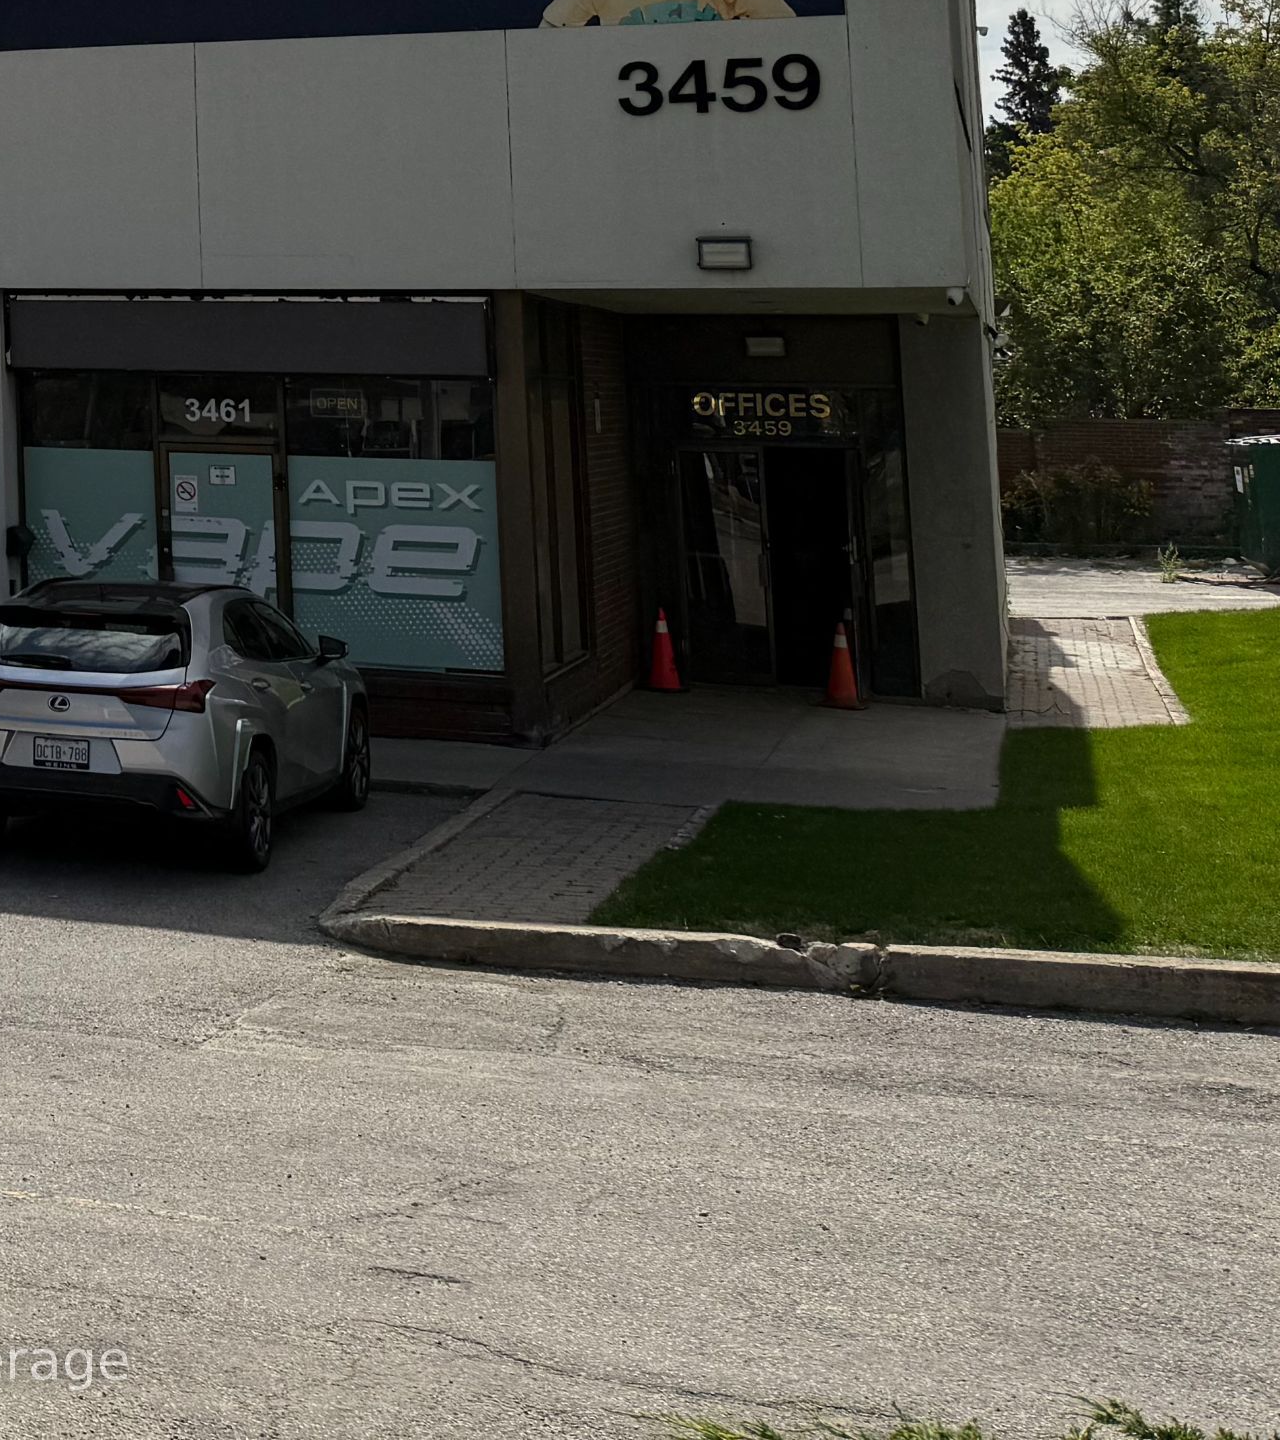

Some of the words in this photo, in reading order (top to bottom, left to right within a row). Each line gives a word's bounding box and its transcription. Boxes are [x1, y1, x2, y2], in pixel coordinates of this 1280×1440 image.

[618, 54, 820, 116] 3459
[185, 397, 251, 423] 3461
[316, 397, 358, 410] OPEN
[692, 392, 832, 419] OFFICES
[733, 420, 792, 436] 3459
